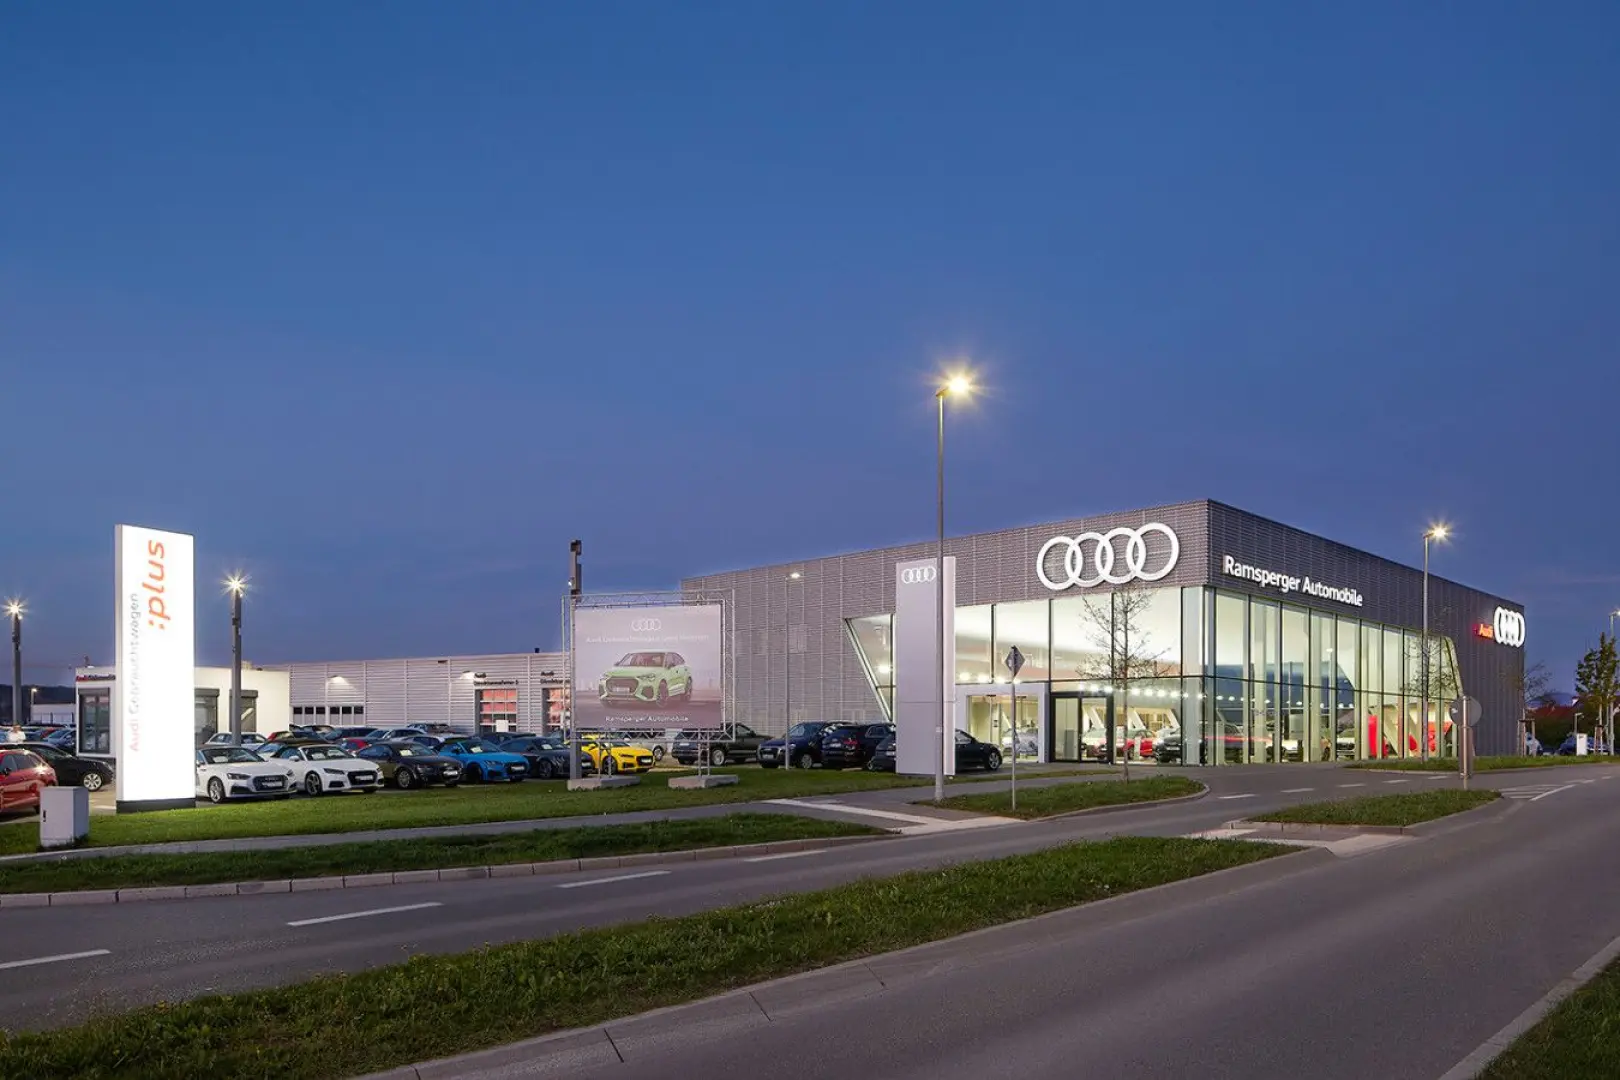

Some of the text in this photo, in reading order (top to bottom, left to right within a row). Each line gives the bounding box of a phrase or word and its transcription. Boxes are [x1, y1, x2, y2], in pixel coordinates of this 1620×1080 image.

[141, 540, 171, 630] :plus
[1222, 554, 1363, 607] Ramsperger Automobile
[128, 593, 141, 752] Audi Gebrauchtwagen
